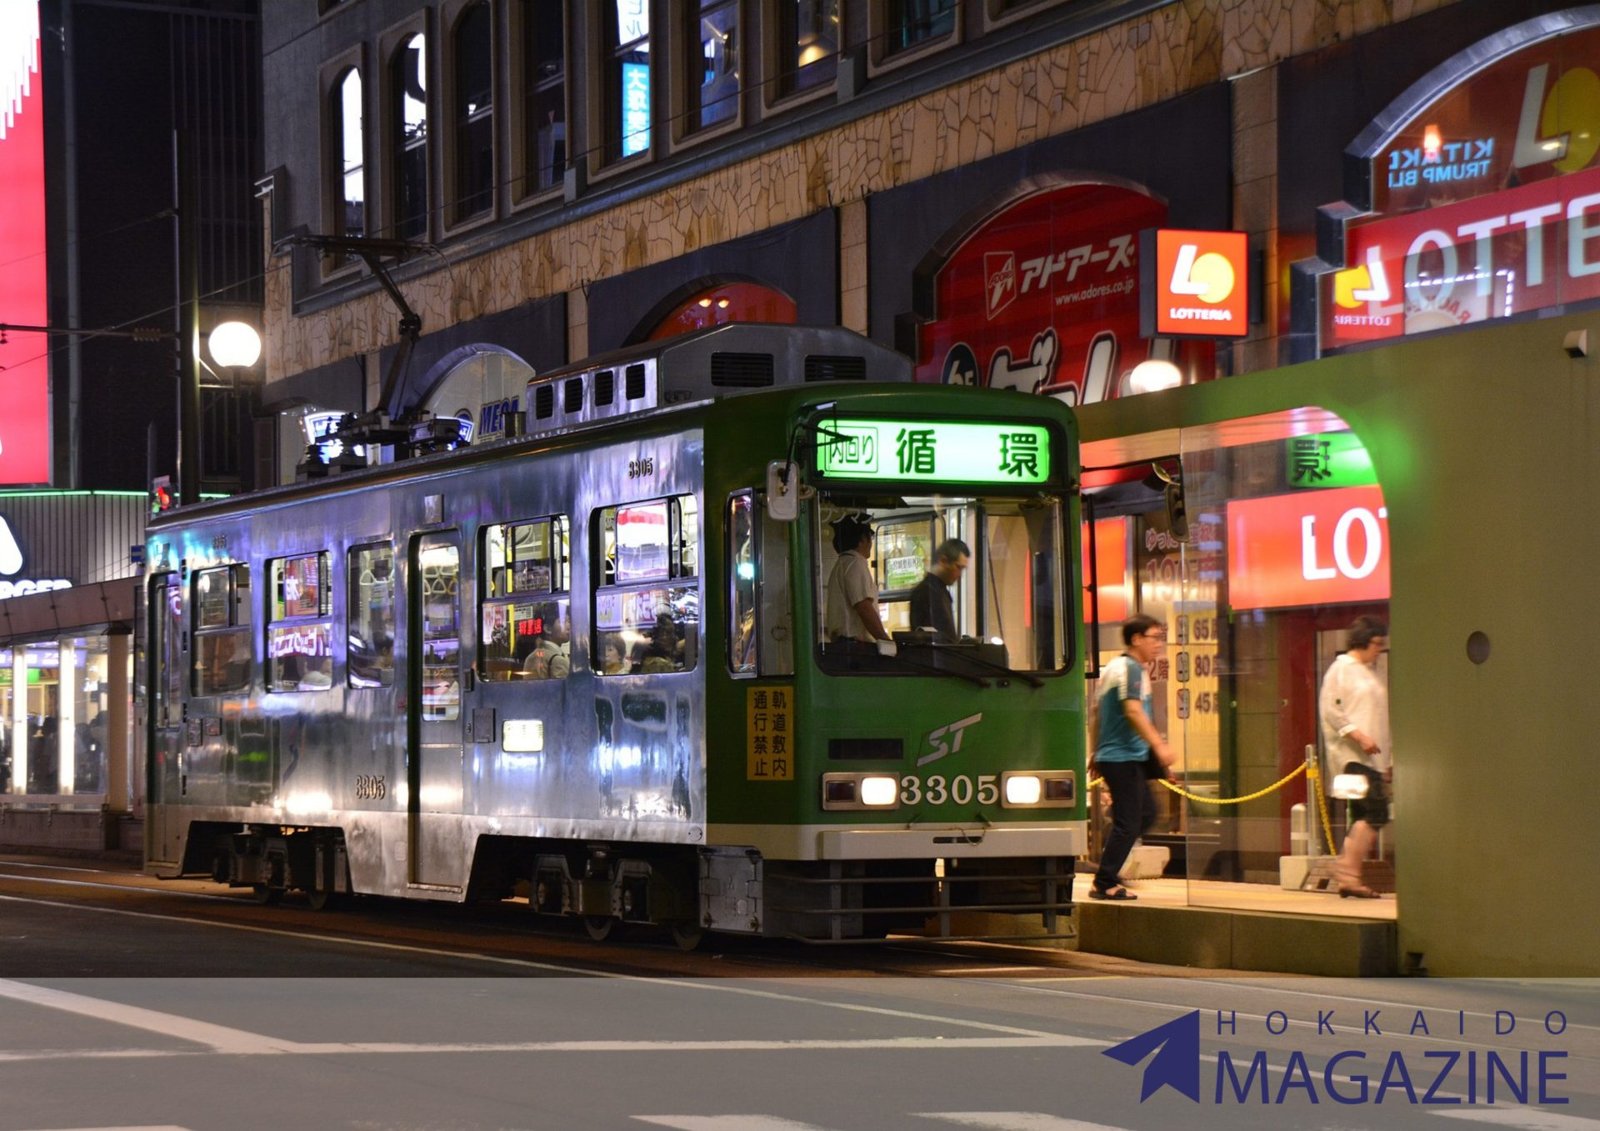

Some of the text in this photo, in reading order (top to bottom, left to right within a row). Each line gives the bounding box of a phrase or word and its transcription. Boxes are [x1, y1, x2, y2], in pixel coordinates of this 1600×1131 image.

[1021, 234, 1135, 293] アドアーズ
[1055, 278, 1135, 305] www.adores.co.jp
[1170, 307, 1232, 321] LOTTERIA
[628, 457, 653, 480] 3305
[1302, 507, 1388, 580] LO
[753, 690, 768, 777] 通行禁止
[772, 690, 787, 777] 軌道敷内
[356, 774, 385, 800] 3305
[900, 775, 999, 805] 3305
